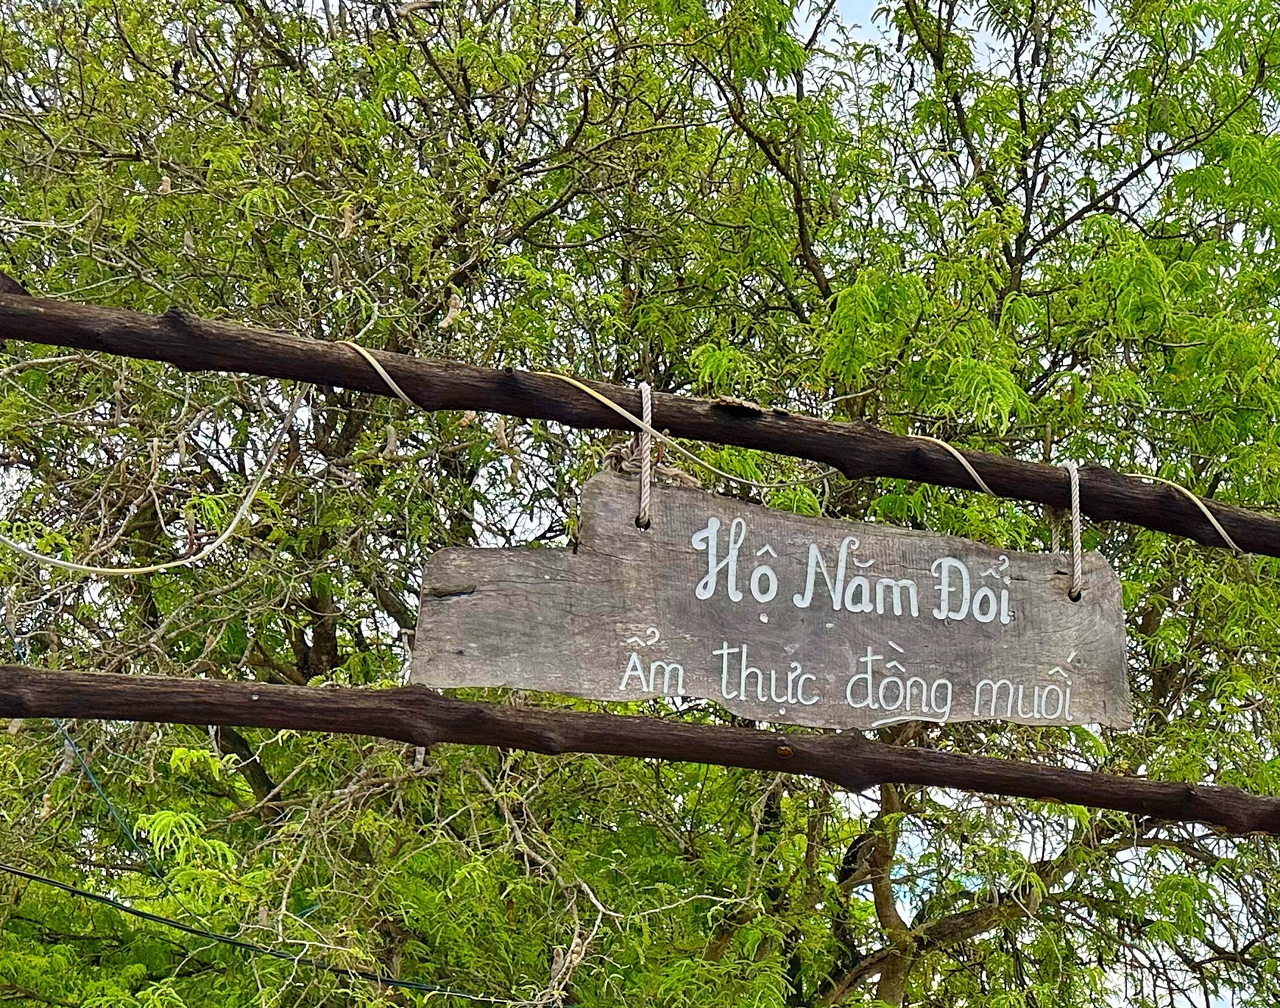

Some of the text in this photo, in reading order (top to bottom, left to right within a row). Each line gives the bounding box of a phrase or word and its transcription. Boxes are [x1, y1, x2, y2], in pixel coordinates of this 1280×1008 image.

[692, 517, 1011, 625] Hộ Năm Đổi
[619, 628, 1075, 728] Ẩm thực đồng muối
